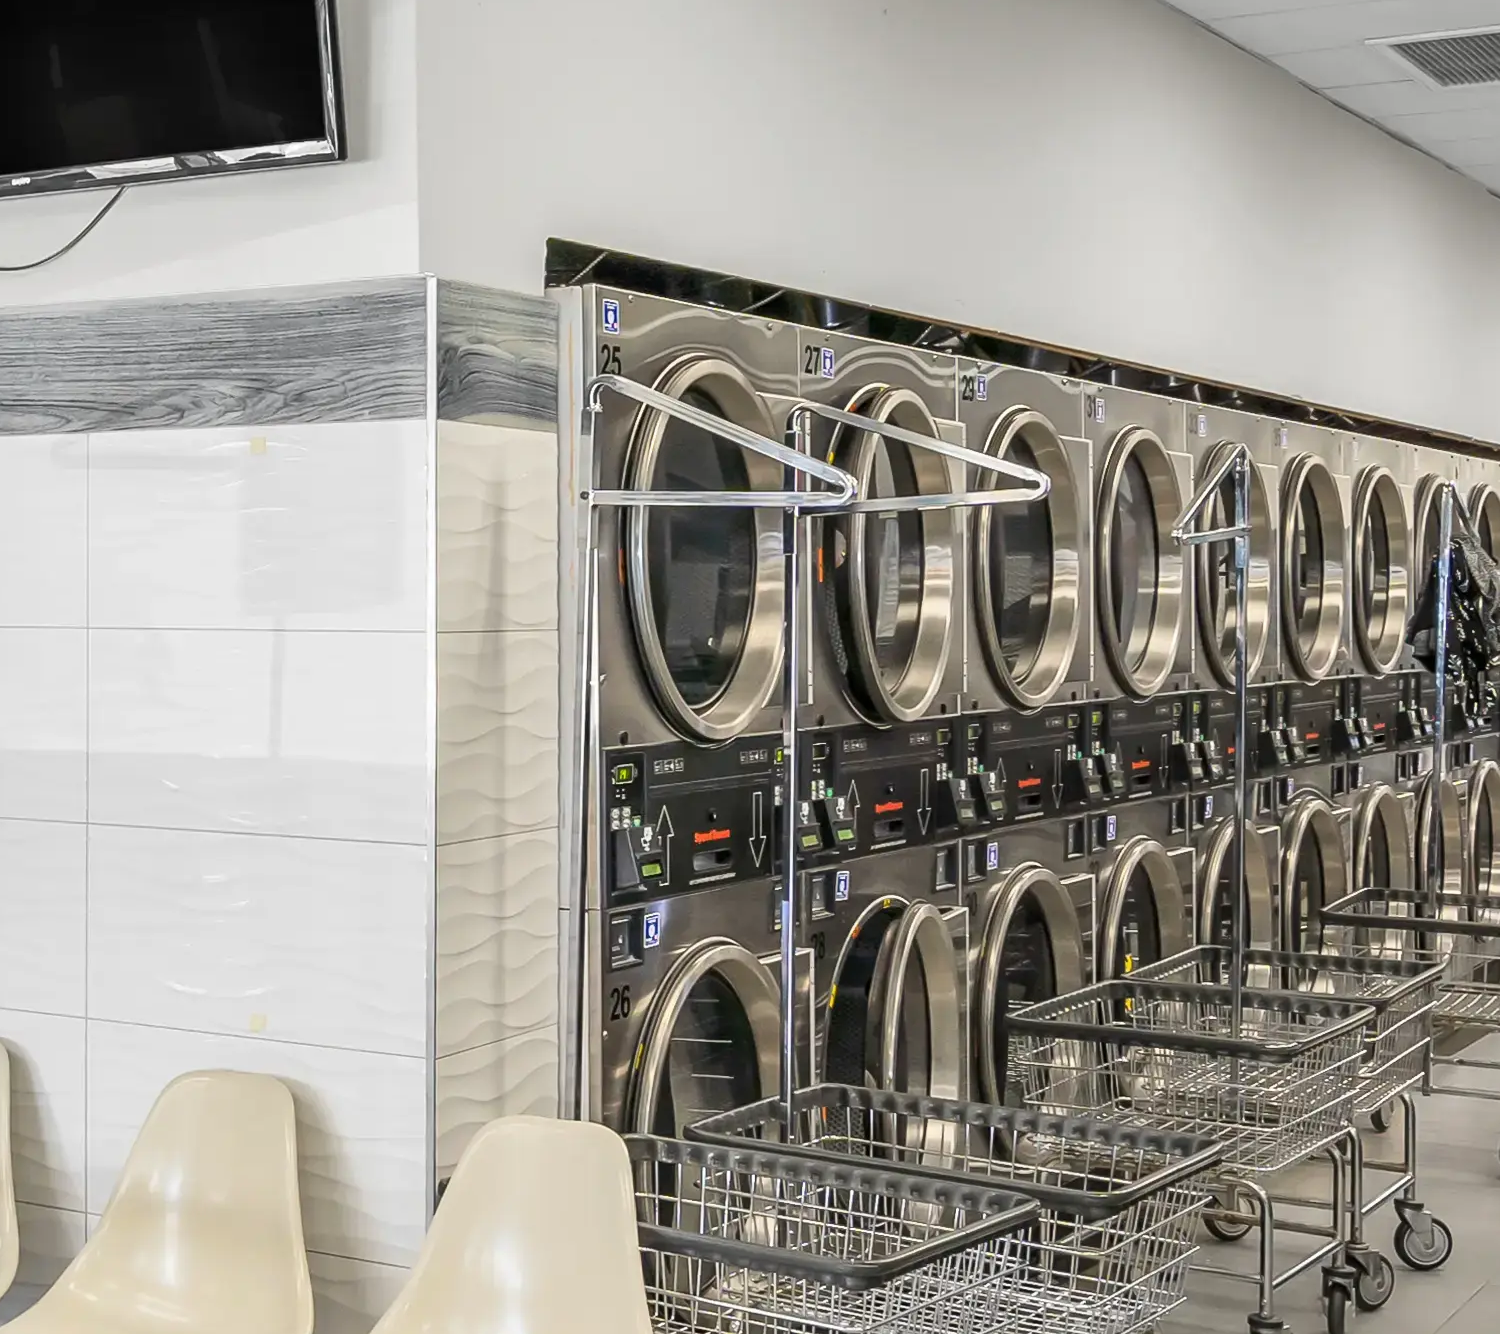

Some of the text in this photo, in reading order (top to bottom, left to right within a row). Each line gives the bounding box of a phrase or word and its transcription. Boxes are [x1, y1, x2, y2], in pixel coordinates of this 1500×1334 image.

[600, 343, 622, 375] 25
[805, 345, 820, 375] 27
[962, 374, 975, 401] 29
[610, 985, 632, 1021] 26
